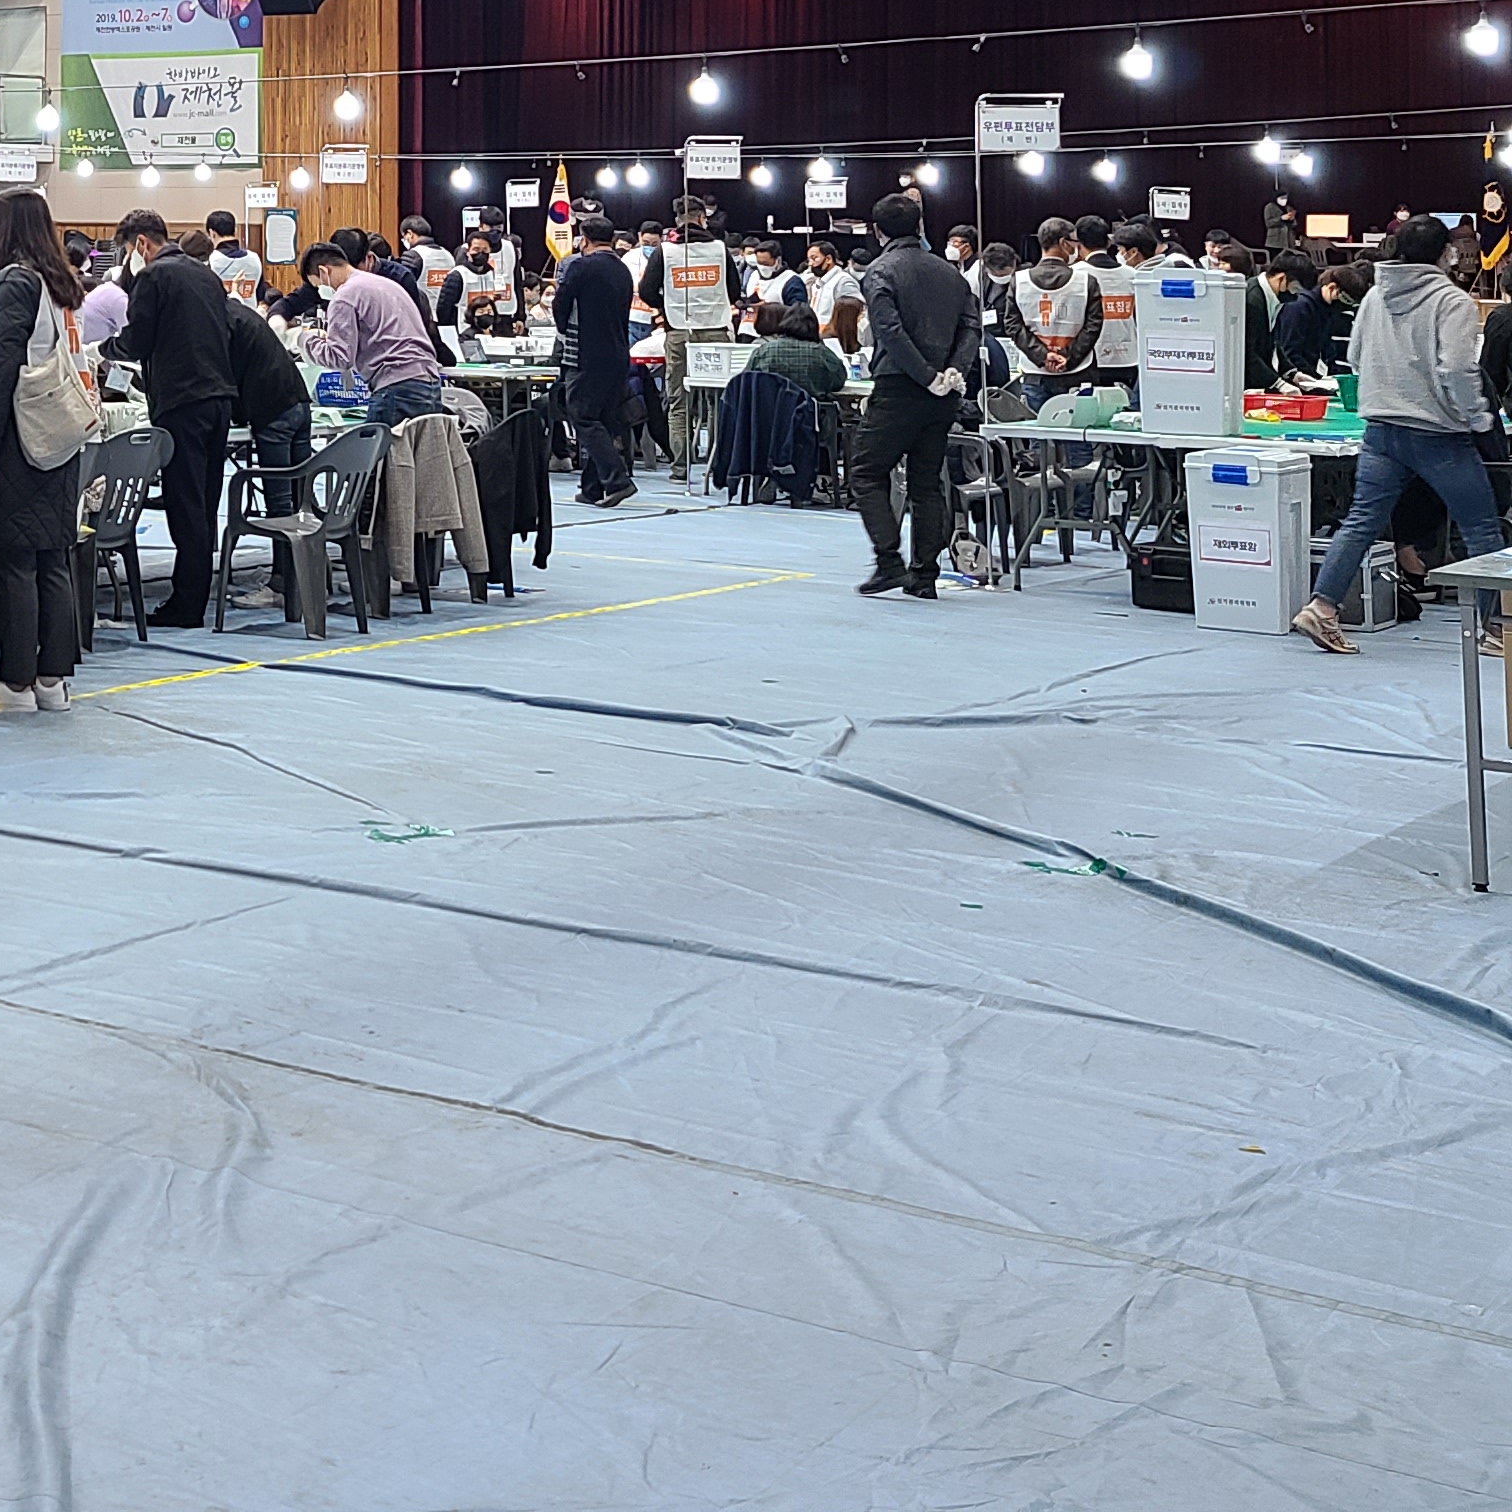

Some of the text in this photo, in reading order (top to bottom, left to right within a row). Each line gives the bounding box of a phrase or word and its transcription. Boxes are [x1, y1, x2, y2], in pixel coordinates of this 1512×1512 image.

[166, 66, 221, 82] 한방바이오
[982, 120, 1057, 134] 우편투표전담부
[1212, 538, 1258, 553] 재외투표함
